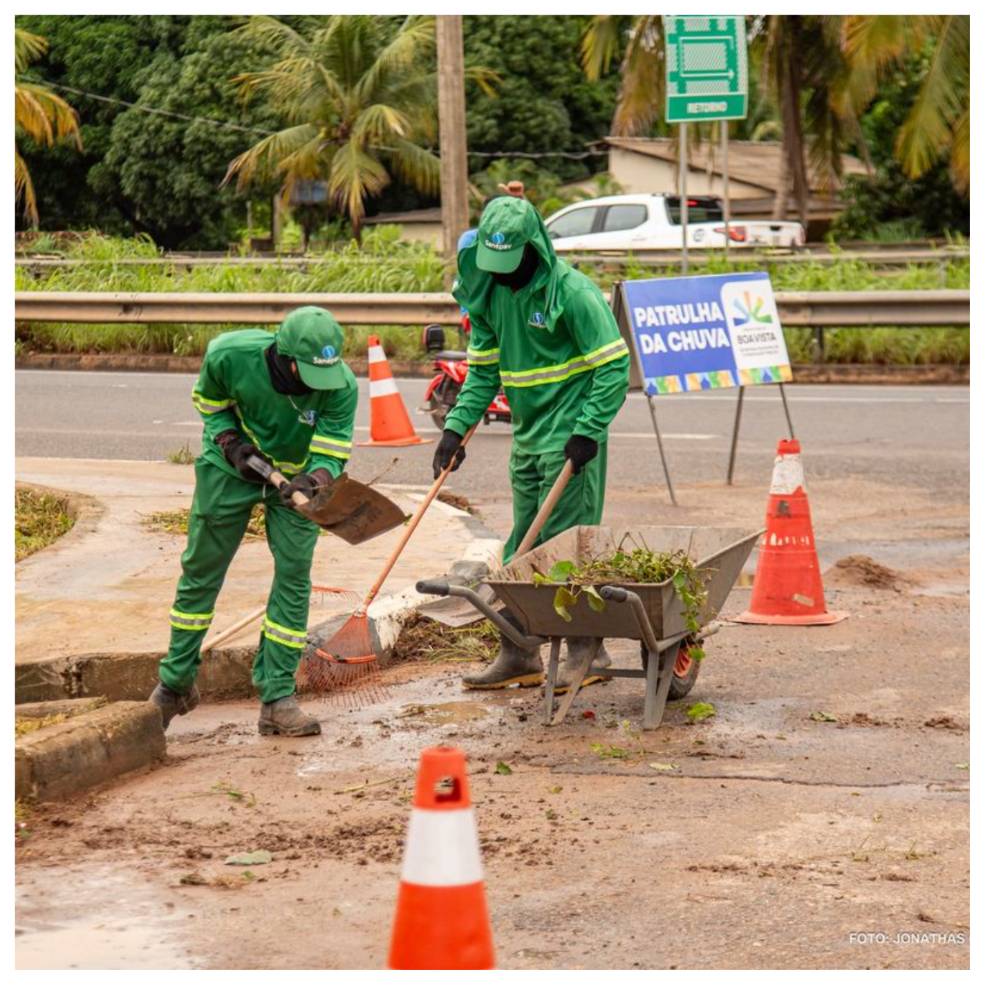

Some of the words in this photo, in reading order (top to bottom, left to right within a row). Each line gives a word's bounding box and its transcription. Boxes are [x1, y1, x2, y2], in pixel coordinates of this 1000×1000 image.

[633, 301, 725, 327] PATRULHA
[639, 332, 667, 354] DA
[667, 327, 730, 351] CHUVA
